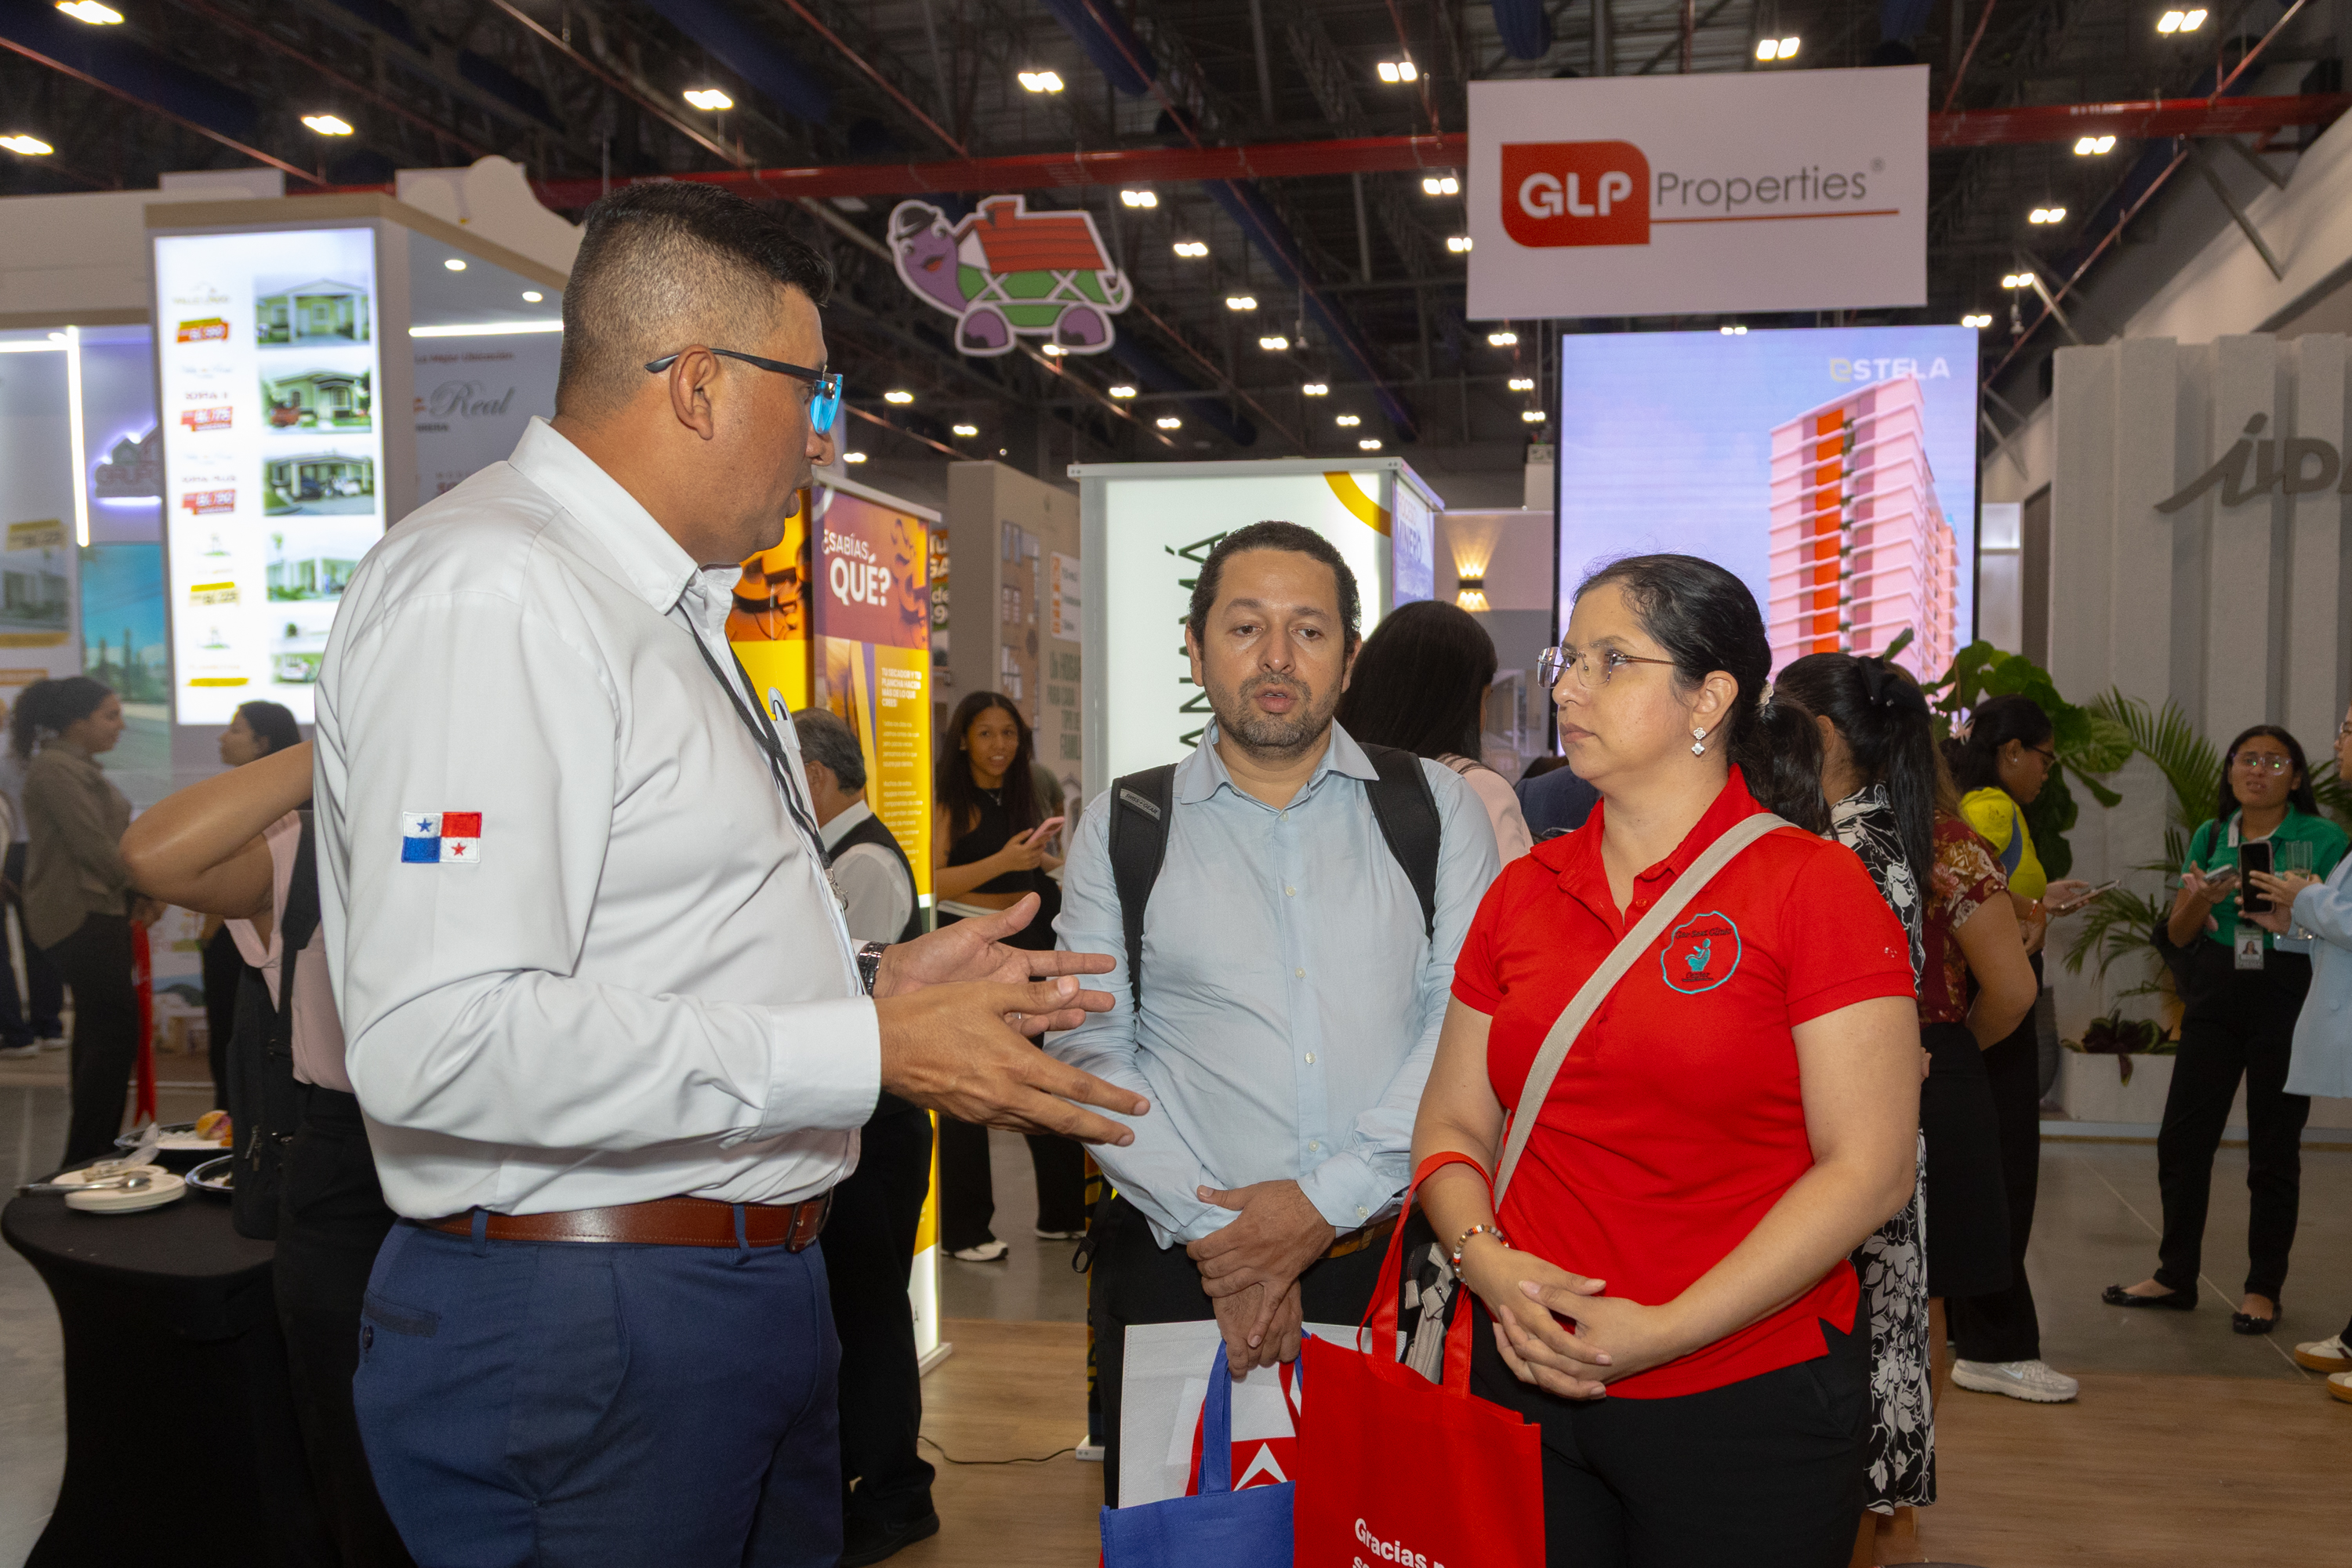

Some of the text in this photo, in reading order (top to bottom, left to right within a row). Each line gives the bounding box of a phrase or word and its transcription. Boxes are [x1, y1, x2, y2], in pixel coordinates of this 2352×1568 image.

[1519, 172, 1632, 219] GLP
[429, 379, 515, 419] Real
[829, 553, 892, 607] QUÉ?
[1125, 793, 1158, 815] SWISS GEAR
[1355, 1518, 1427, 1568] Gracias
